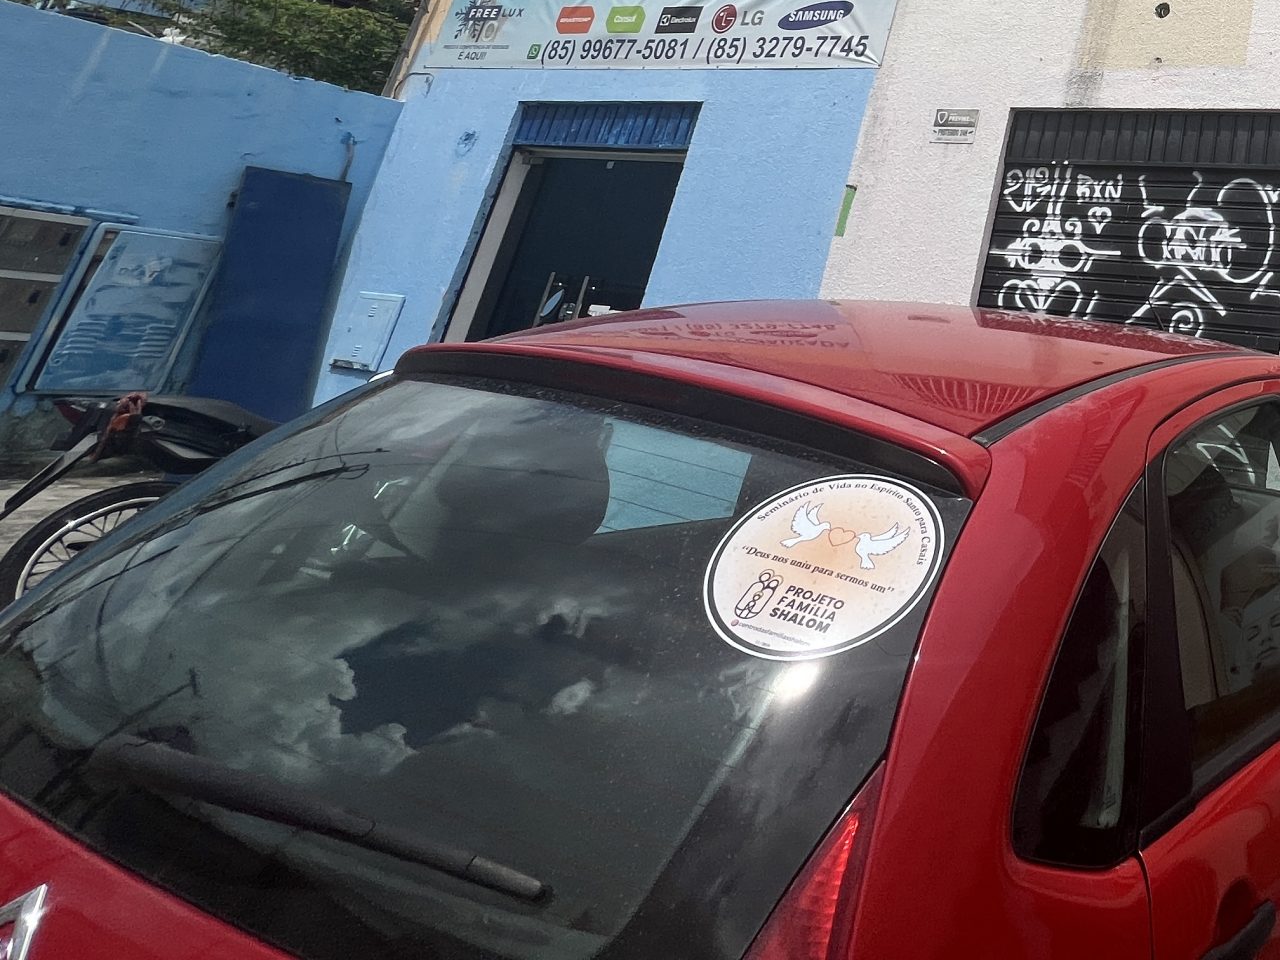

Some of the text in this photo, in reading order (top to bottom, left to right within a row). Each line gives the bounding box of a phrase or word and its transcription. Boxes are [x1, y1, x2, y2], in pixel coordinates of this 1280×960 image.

[468, 8, 525, 18] FREE LUX
[740, 10, 765, 26] LG
[788, 9, 845, 22] SAMSUNG
[541, 39, 577, 65] (85)
[579, 37, 689, 61] 99677-5081
[706, 37, 747, 64] (85)
[752, 35, 870, 59] 3279-7745
[828, 482, 852, 490] Vida
[869, 483, 905, 500] Espírito
[757, 491, 810, 521] Seminário
[903, 496, 922, 517] Santo
[915, 516, 928, 535] para
[916, 535, 931, 566] Casais
[772, 554, 790, 564] nos
[789, 558, 812, 570] uniu
[811, 564, 835, 577] para
[834, 571, 870, 587] sermos
[785, 585, 845, 610] PROJETO
[769, 607, 832, 634] SHALOM
